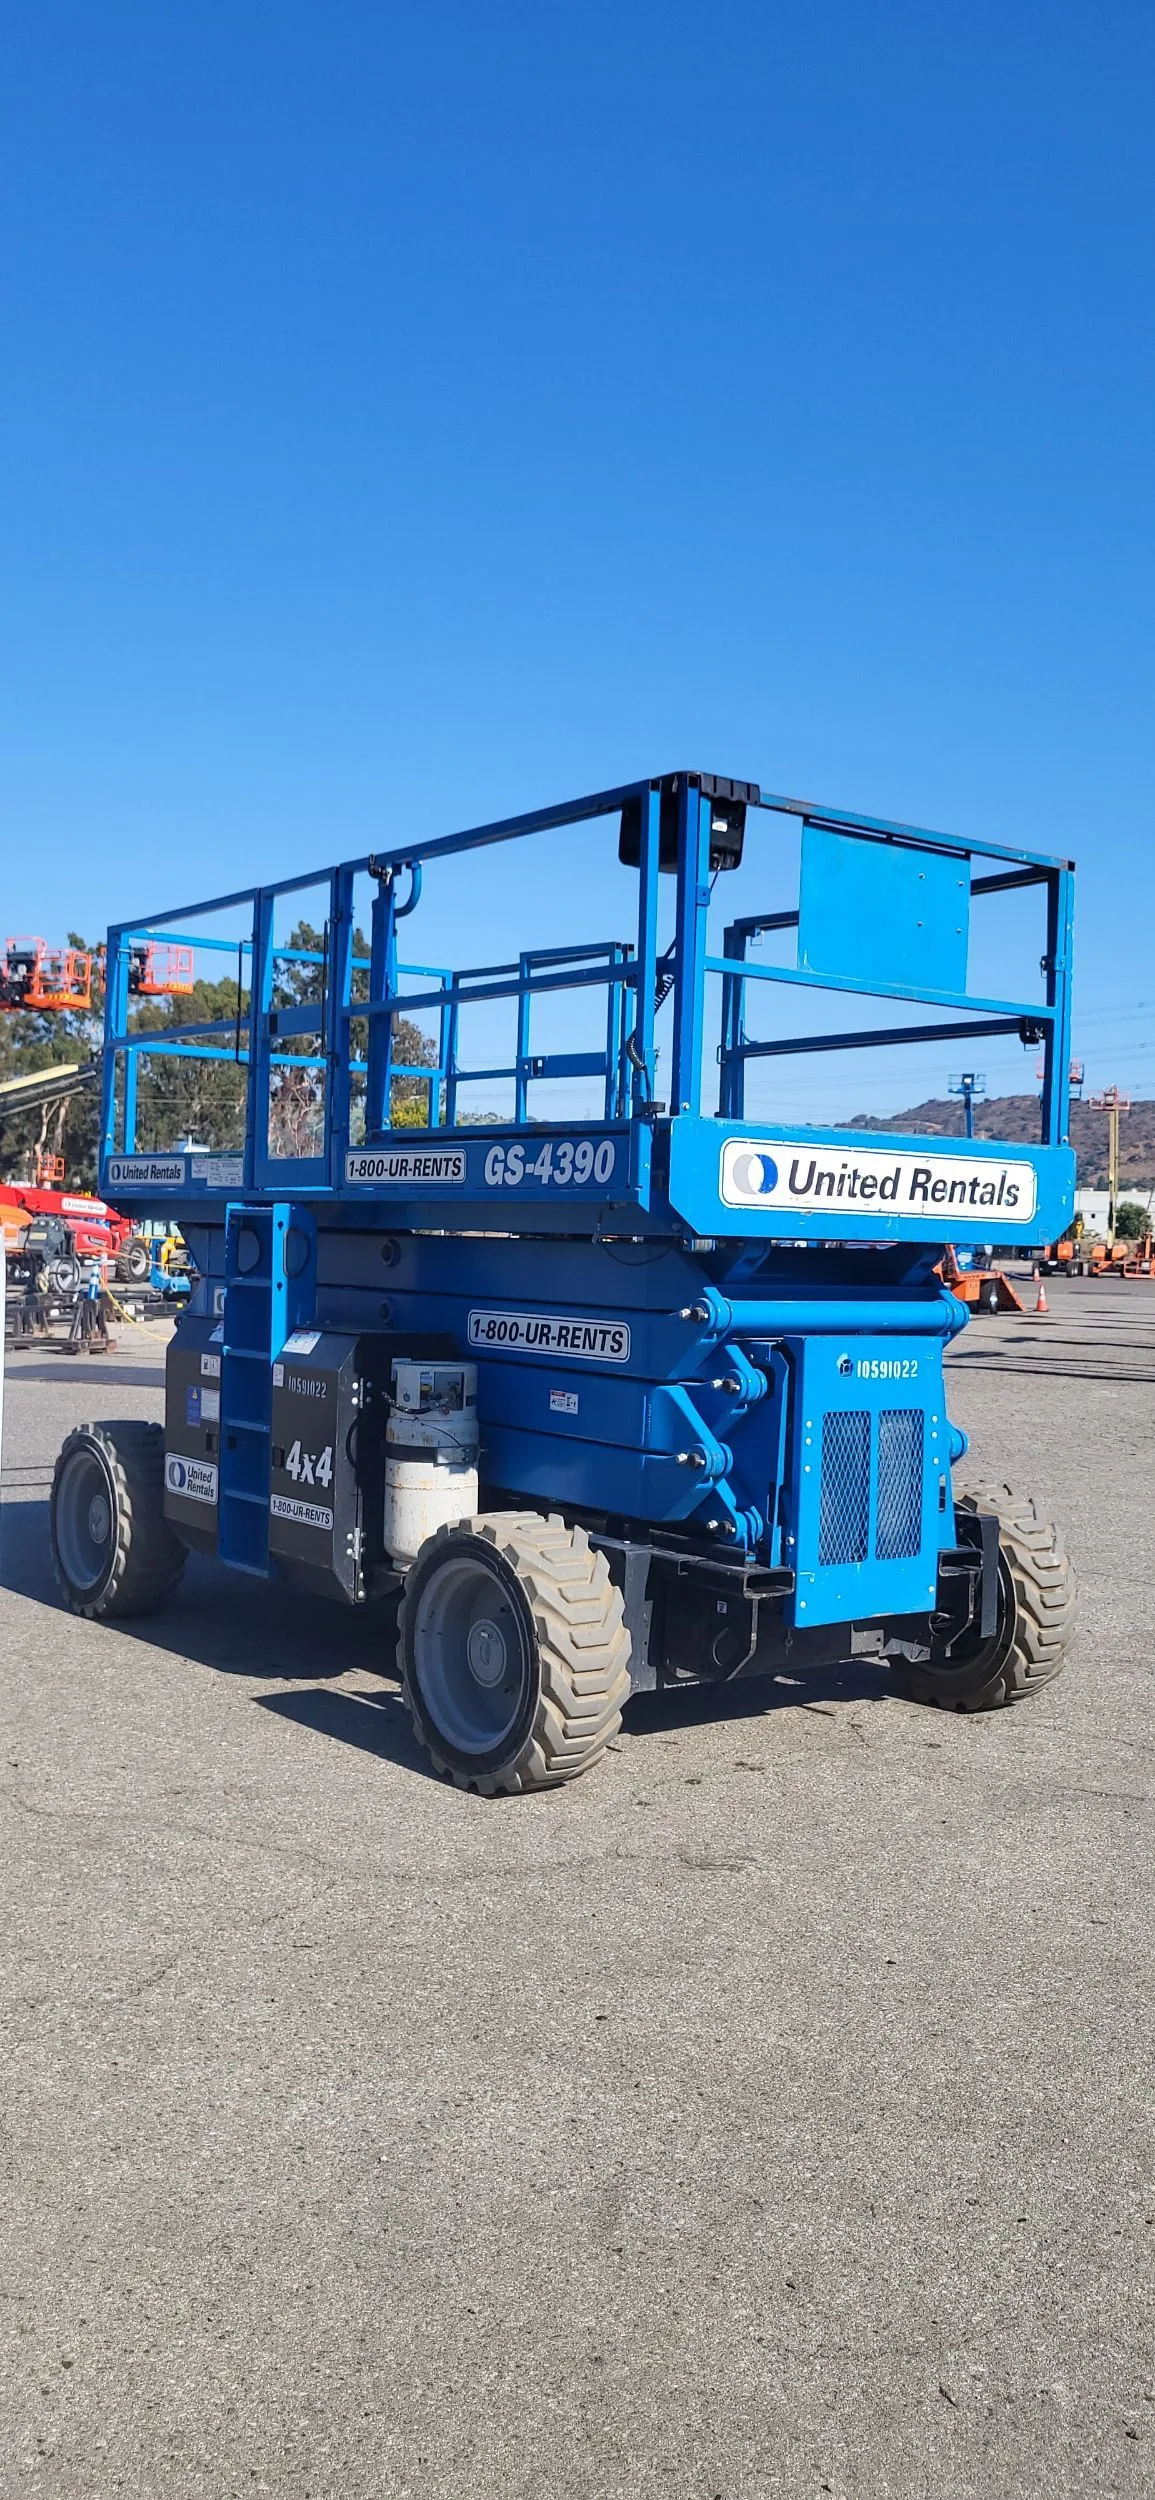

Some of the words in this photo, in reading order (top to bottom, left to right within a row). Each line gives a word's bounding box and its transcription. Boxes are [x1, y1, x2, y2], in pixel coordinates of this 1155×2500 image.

[122, 1164, 148, 1180] United
[150, 1164, 181, 1180] Rentals
[348, 1154, 463, 1179] 1-800-UR-RENTS
[484, 1139, 615, 1186] GS-4390
[788, 1160, 900, 1200] United
[909, 1167, 1020, 1207] Rentals
[473, 1318, 624, 1353] 1-800-UR-RENTS
[857, 1359, 918, 1379] 10591022
[288, 1375, 327, 1398] 10591022
[188, 1465, 212, 1482] United
[285, 1440, 333, 1488] 4x4
[187, 1480, 214, 1498] Rentals
[273, 1501, 331, 1525] 1-800-UR-RENTS
